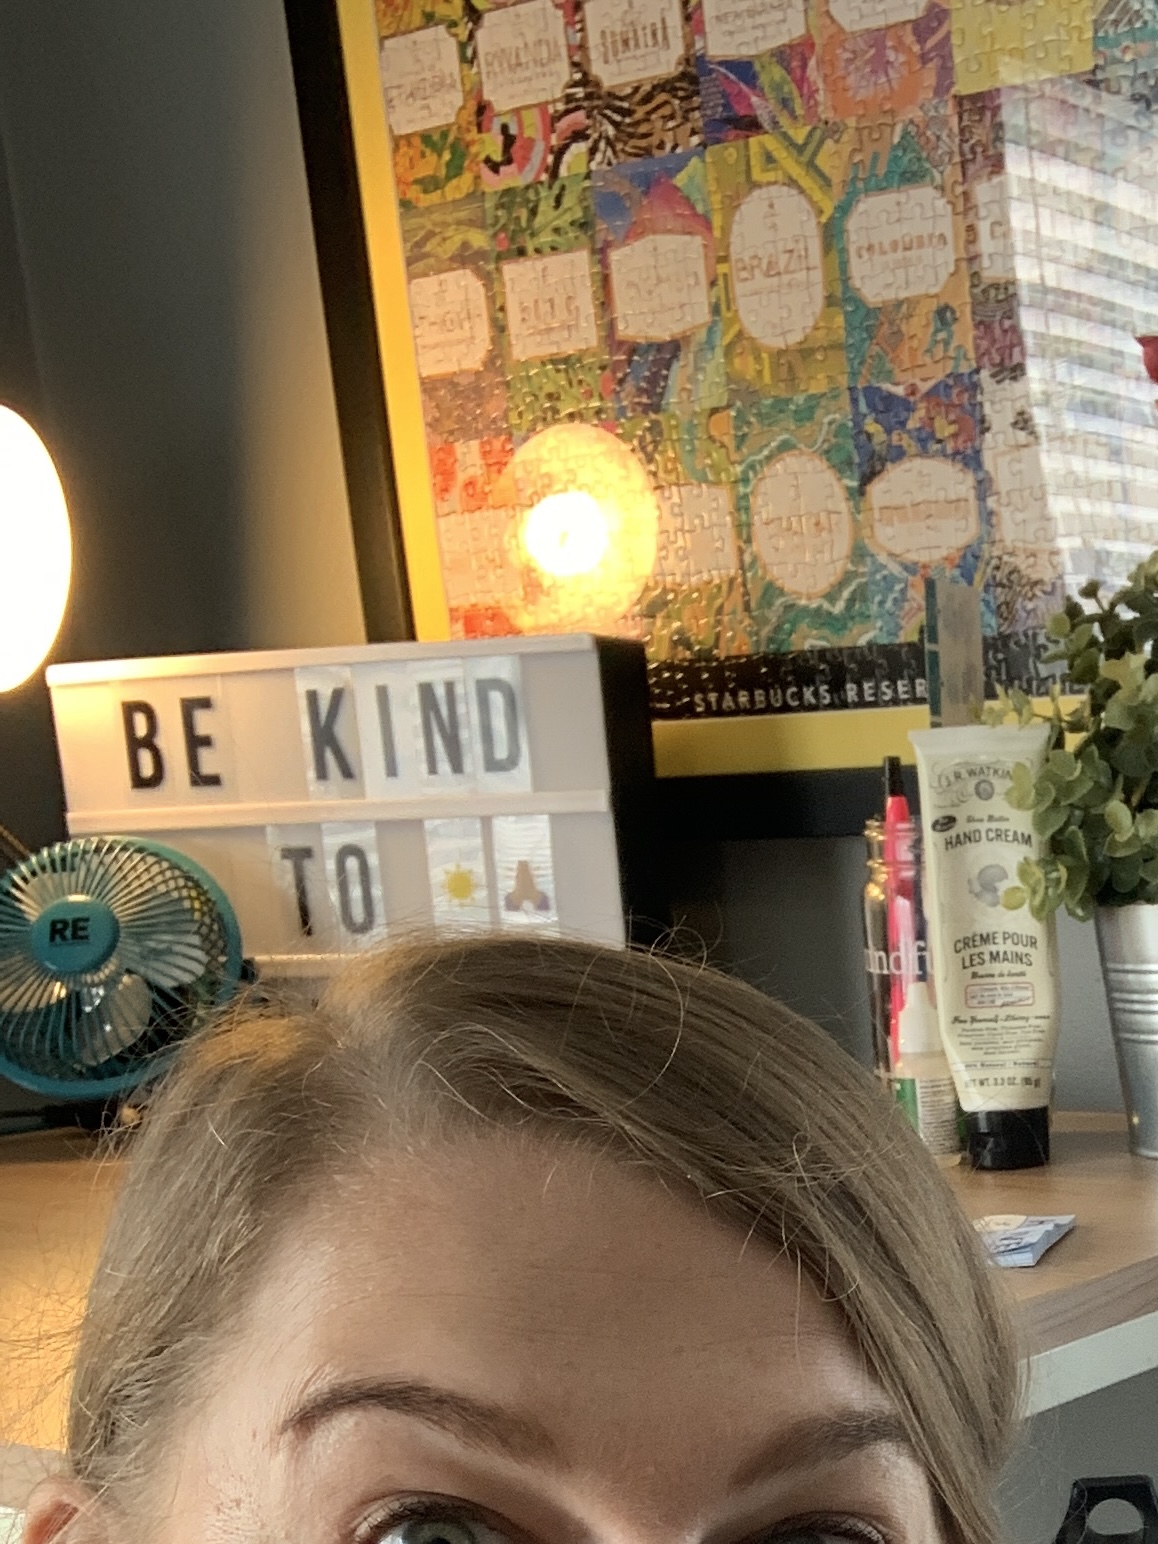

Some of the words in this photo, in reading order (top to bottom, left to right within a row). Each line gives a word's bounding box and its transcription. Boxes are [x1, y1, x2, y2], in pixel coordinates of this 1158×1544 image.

[694, 683, 831, 712] STARBUCKS
[846, 678, 929, 703] RESER
[121, 696, 223, 789] BE
[306, 678, 522, 781] KIND
[944, 829, 982, 851] HAND
[986, 828, 1032, 848] CREAM
[280, 843, 377, 937] TO
[48, 916, 91, 944] RE
[954, 931, 999, 954] CRÈME
[1002, 931, 1038, 950] POUR
[961, 951, 986, 970] LES
[989, 950, 1033, 967] MAINS
